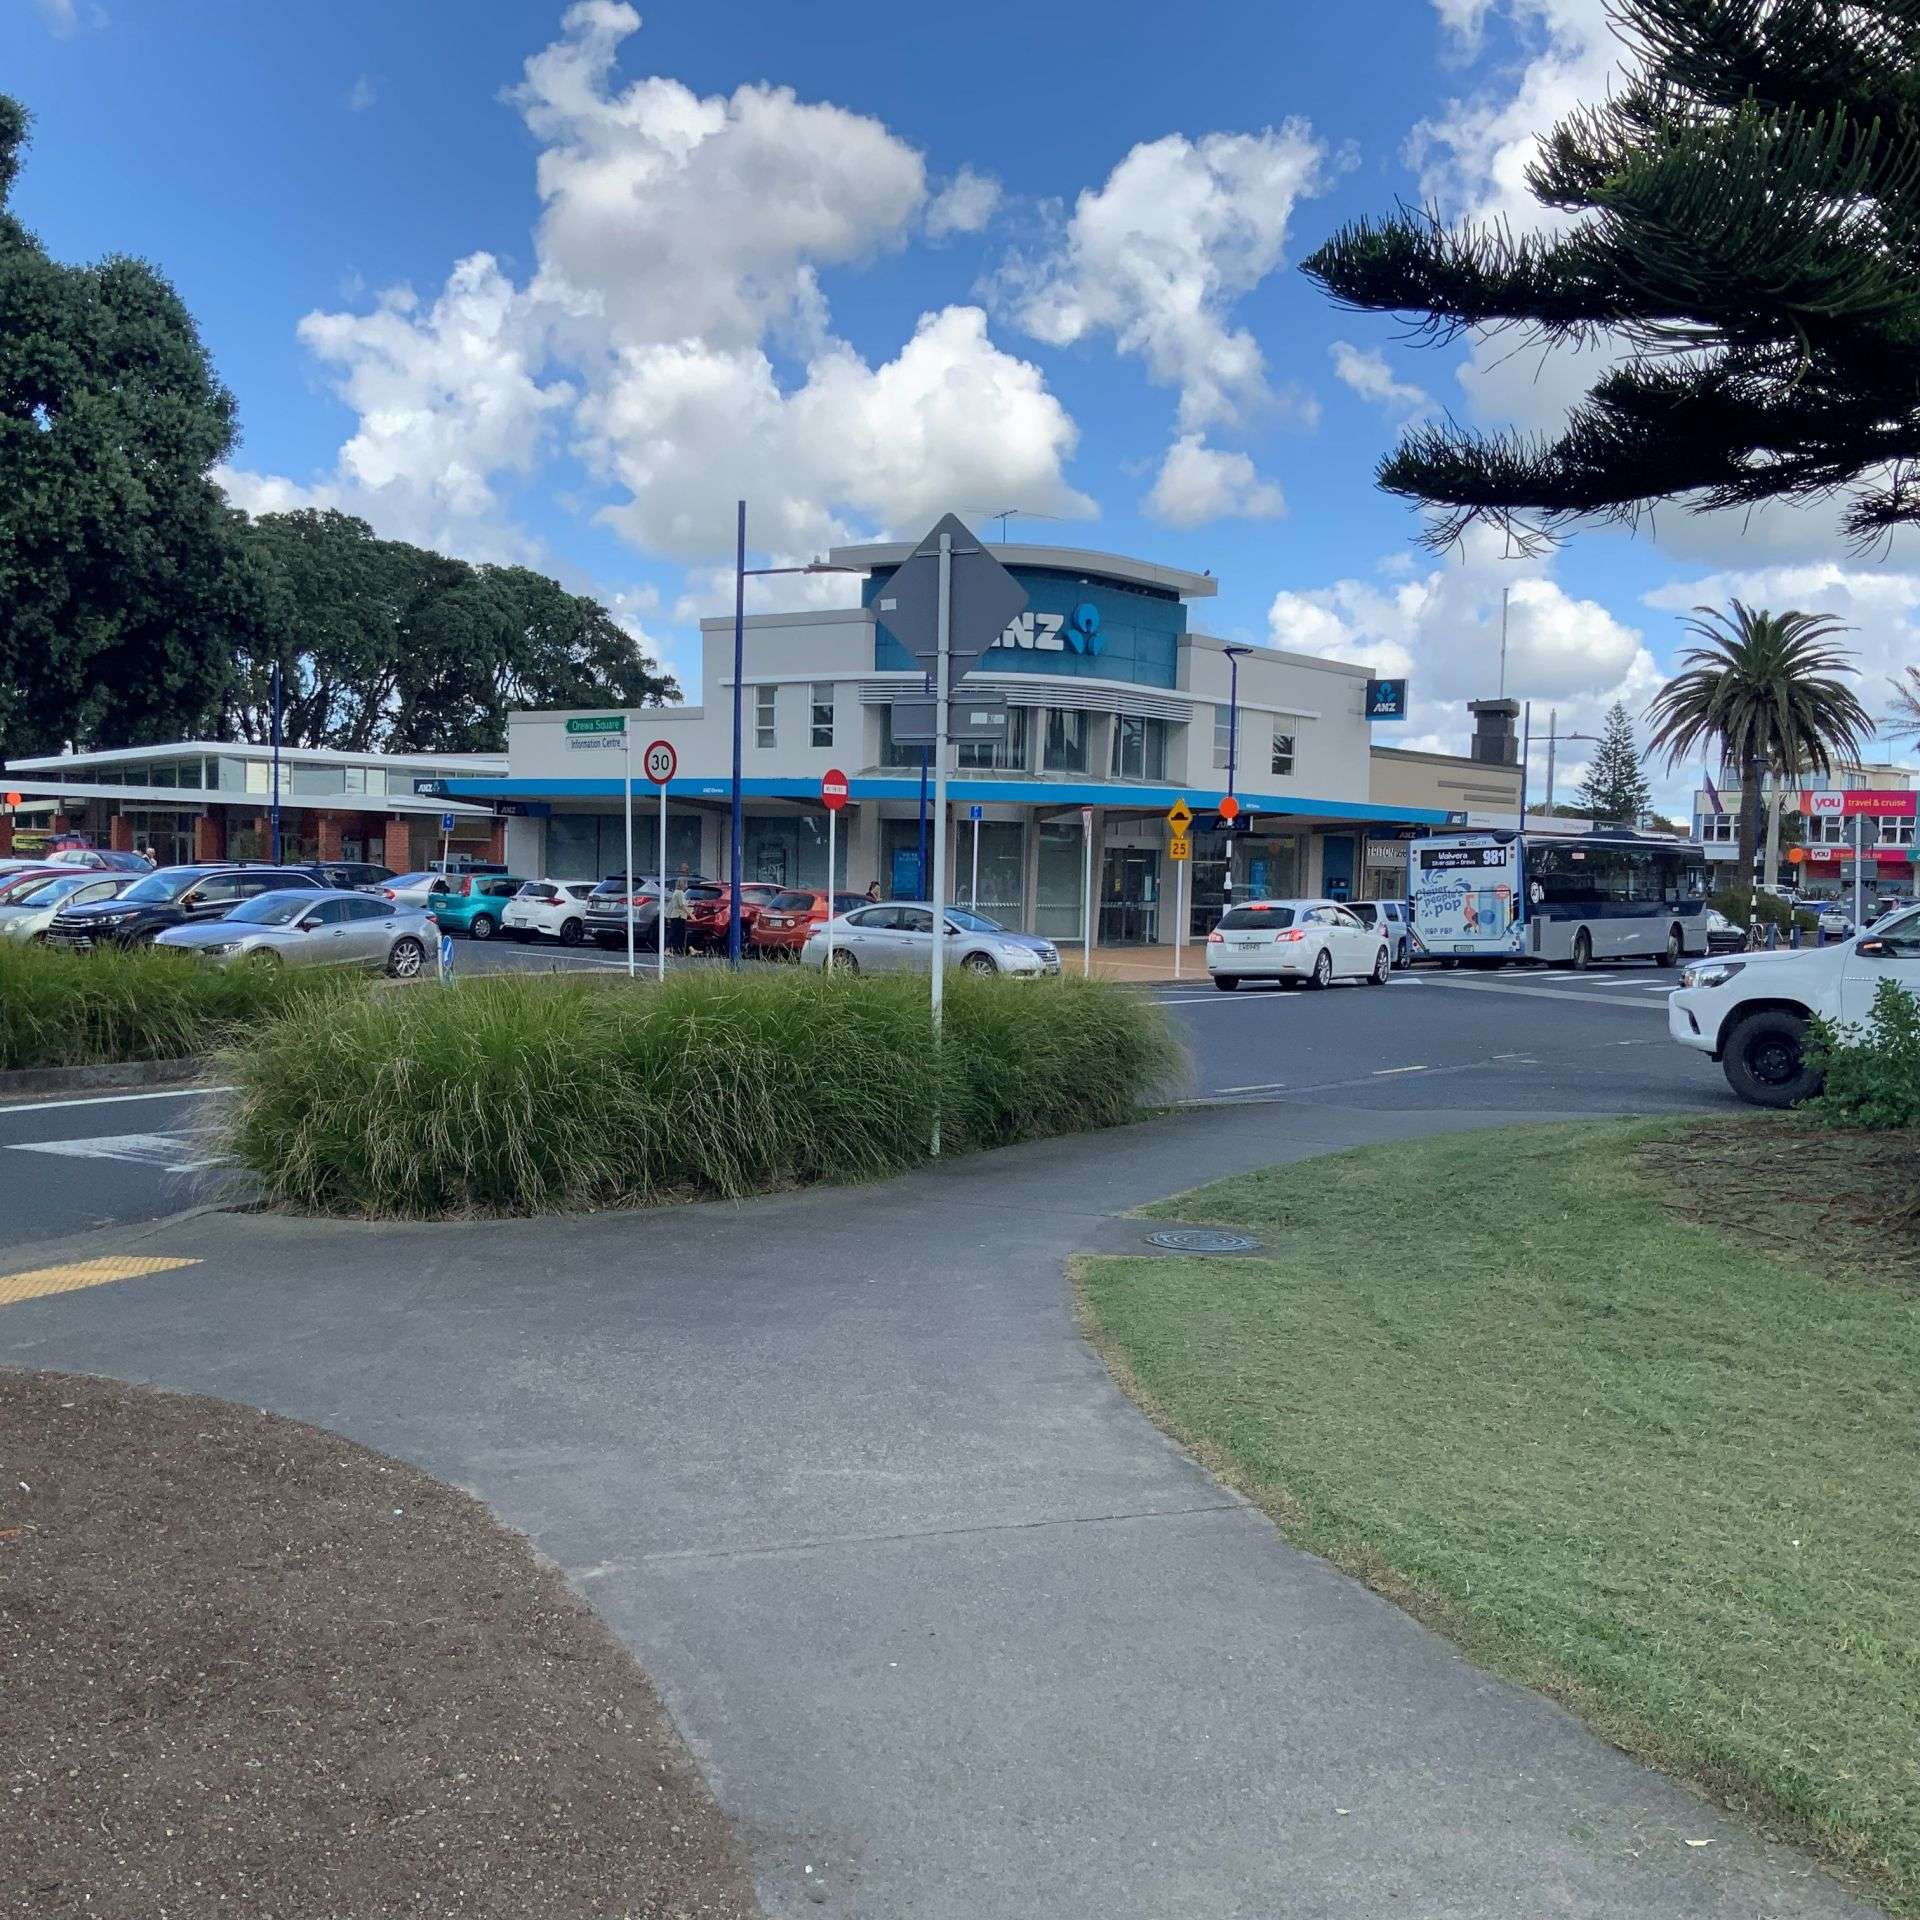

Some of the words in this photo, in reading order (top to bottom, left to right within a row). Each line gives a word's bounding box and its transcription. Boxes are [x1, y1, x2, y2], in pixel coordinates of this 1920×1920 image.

[991, 612, 1064, 651] NZ
[1373, 702, 1397, 712] ANZ
[572, 721, 594, 731] Orewa
[596, 719, 620, 730] Square
[571, 740, 600, 749] Information
[602, 738, 620, 748] Centre
[651, 754, 670, 771] 30
[418, 784, 433, 793] ANZ
[1814, 798, 1840, 811] you
[1848, 799, 1872, 808] travel
[1873, 799, 1880, 807] &
[1881, 799, 1907, 807] cruise
[501, 806, 516, 814] ANZ
[1173, 843, 1186, 855] 25
[1483, 849, 1505, 866] 981
[1435, 900, 1462, 918] pop
